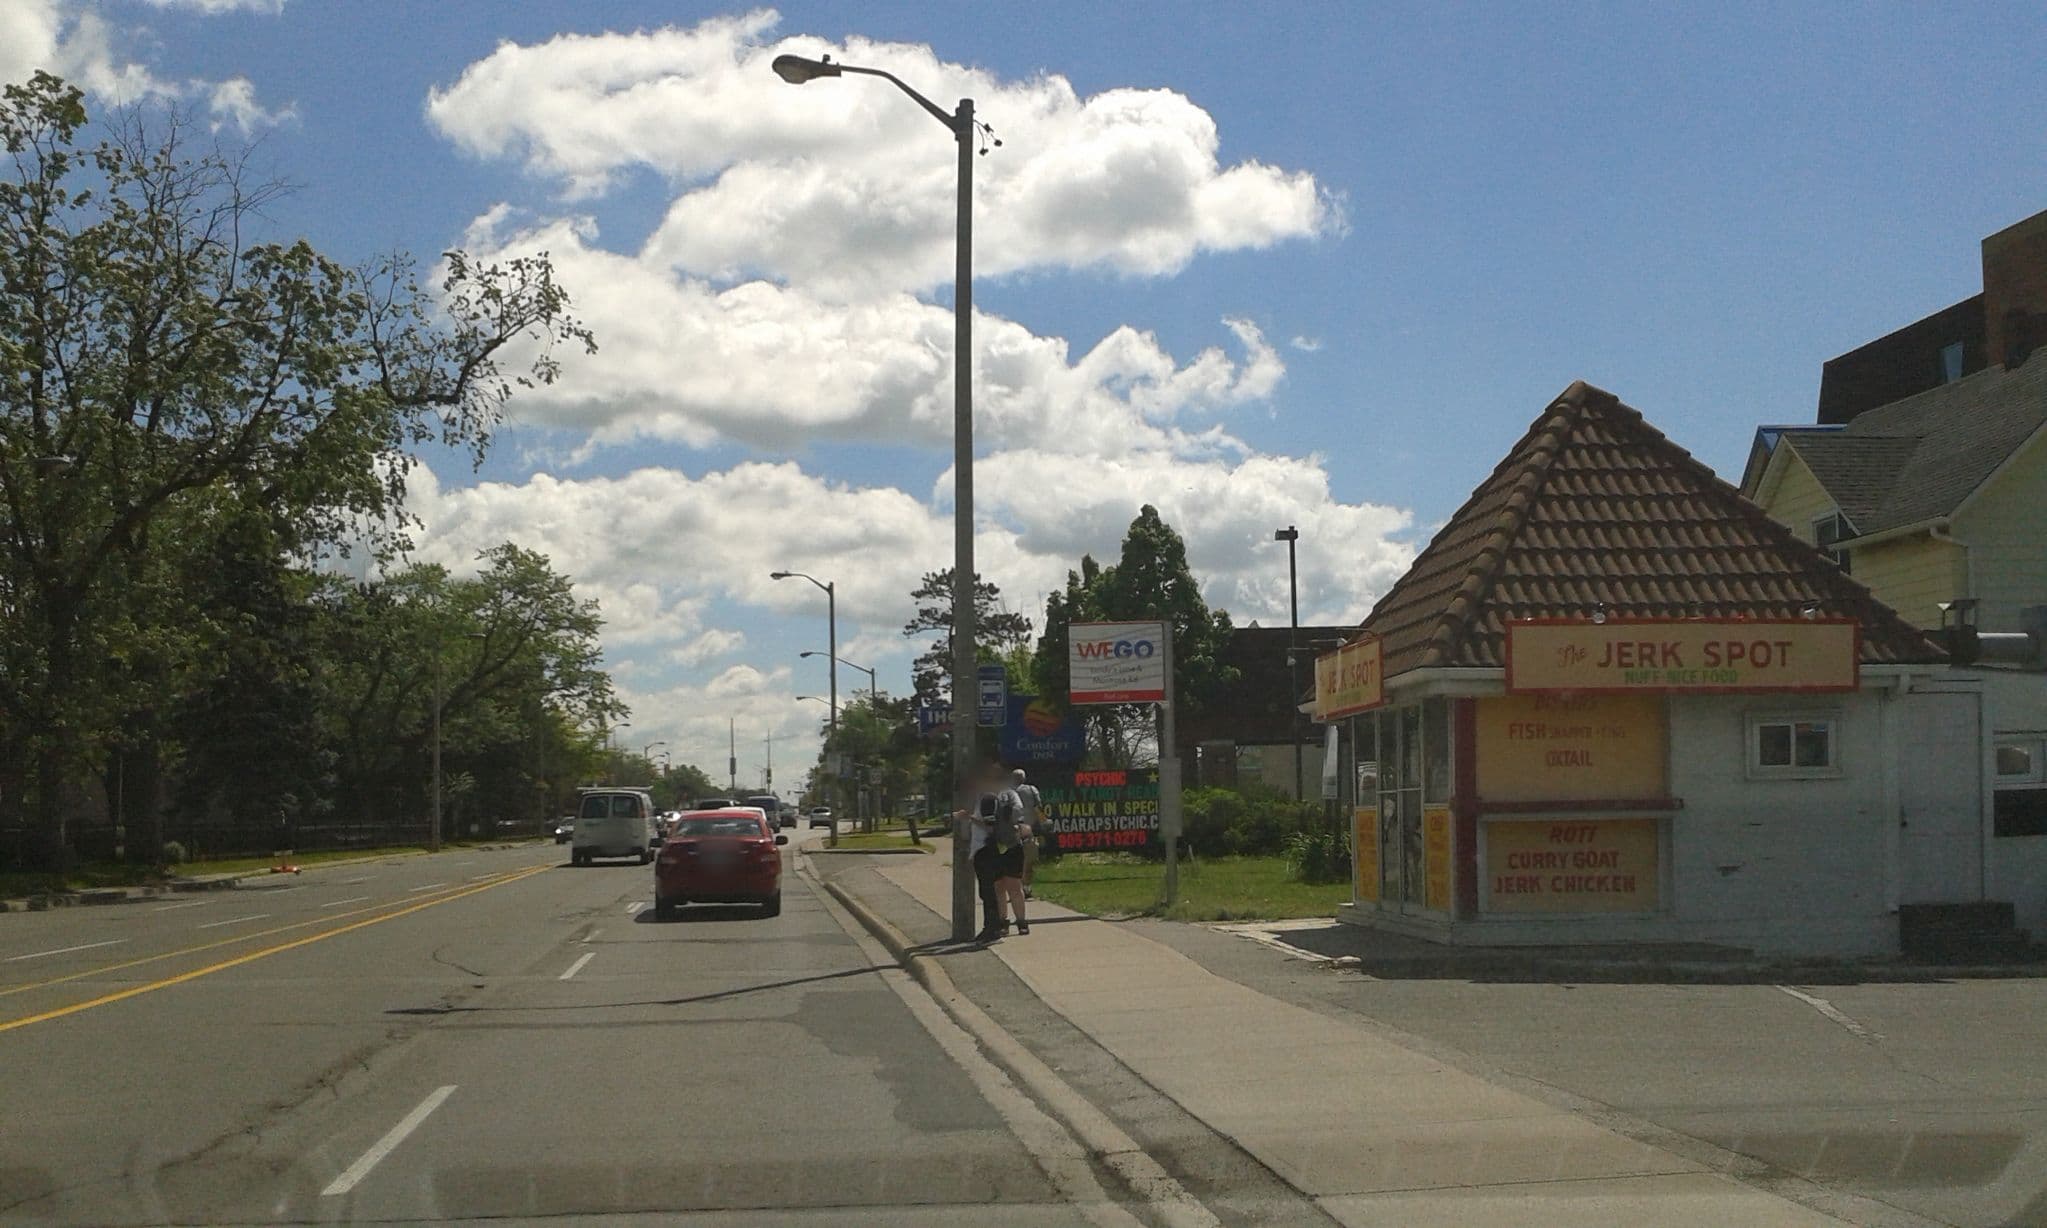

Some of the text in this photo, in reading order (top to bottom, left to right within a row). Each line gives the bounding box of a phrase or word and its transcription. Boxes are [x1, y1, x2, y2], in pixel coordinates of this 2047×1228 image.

[1076, 640, 1154, 659] WEGO
[1597, 640, 1684, 668] JERK
[1703, 640, 1793, 668] SPOT
[1327, 671, 1347, 695] JEK
[1702, 669, 1738, 684] FOOD
[1508, 722, 1546, 740] FISH
[1075, 770, 1127, 786] PSYCHIC
[1058, 802, 1096, 817] WALK
[1104, 801, 1117, 815] IN
[1550, 825, 1598, 843] ROTI
[1508, 851, 1621, 869] CURRY GOAT
[1494, 876, 1636, 893] JERK CHICKEN
